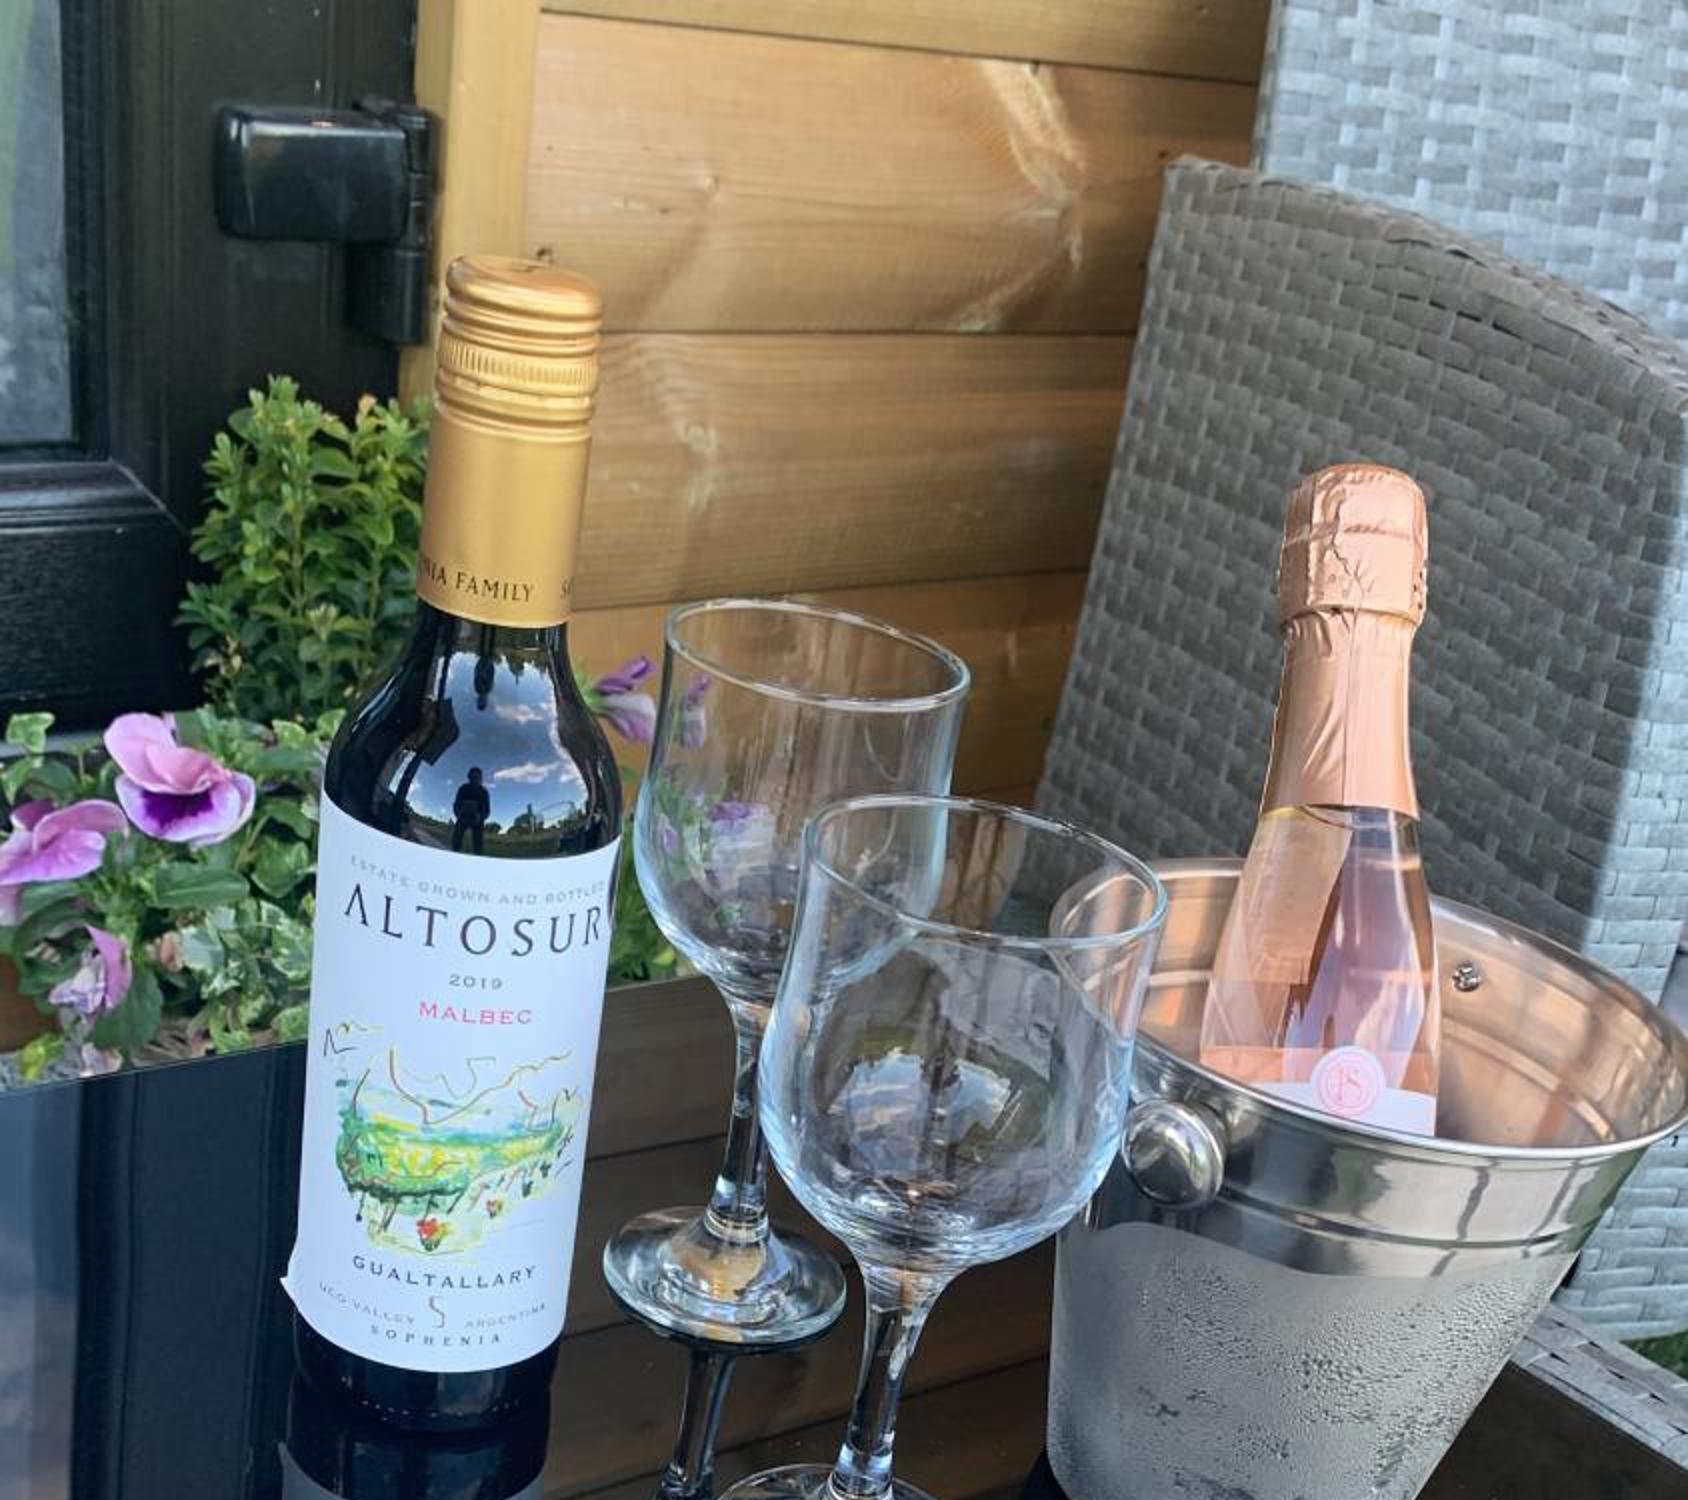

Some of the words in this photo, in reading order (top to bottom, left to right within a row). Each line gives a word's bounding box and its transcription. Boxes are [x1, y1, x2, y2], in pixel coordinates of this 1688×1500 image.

[455, 571, 535, 602] FAMILY
[418, 882, 491, 904] GROWN
[501, 892, 536, 905] AND
[344, 882, 601, 957] ALTOSUR
[449, 973, 503, 990] 2019
[419, 1001, 533, 1025] MALBEC
[353, 1255, 536, 1289] GUALTALLARY
[353, 1301, 416, 1325] VALLEY
[371, 1324, 501, 1347] SOPHENIA
